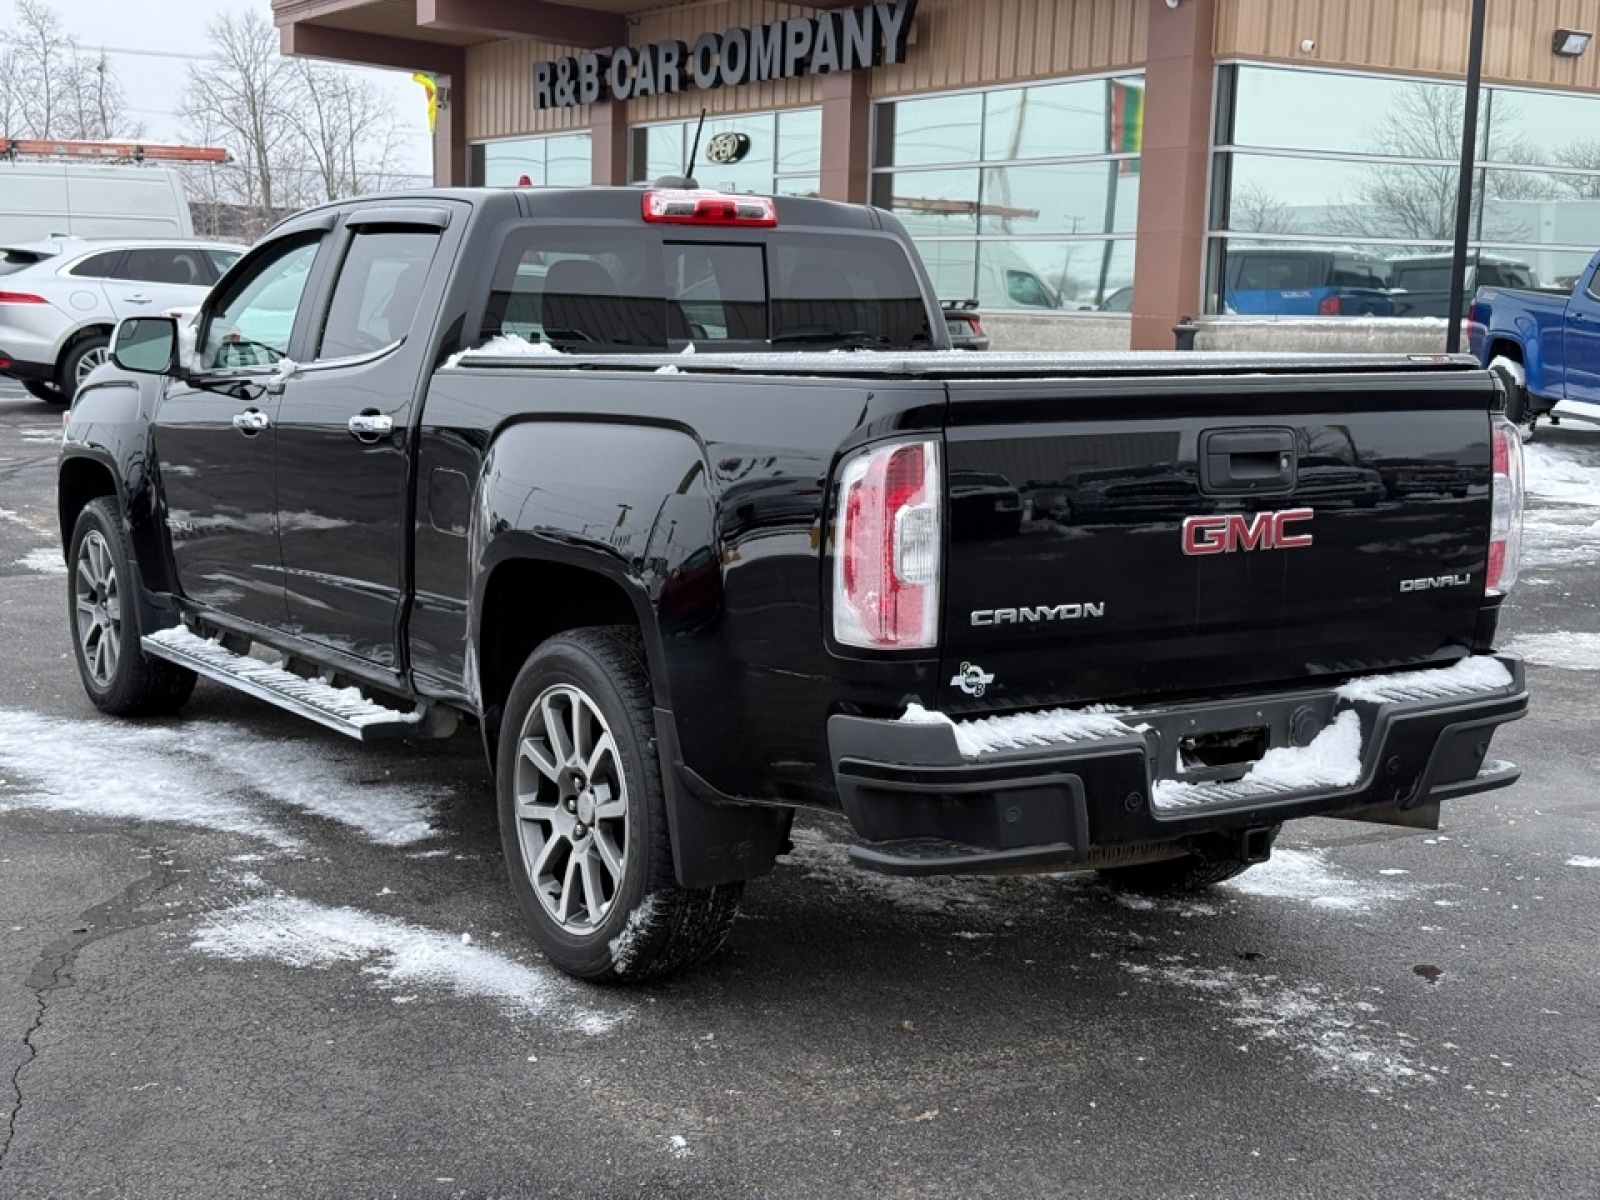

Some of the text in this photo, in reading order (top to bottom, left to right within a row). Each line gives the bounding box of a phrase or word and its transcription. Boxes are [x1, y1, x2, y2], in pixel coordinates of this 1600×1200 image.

[533, 1, 912, 110] R&B CAR COMPANY
[1182, 507, 1314, 556] GMC
[1399, 572, 1471, 593] DENALI
[970, 601, 1105, 626] CANYON
